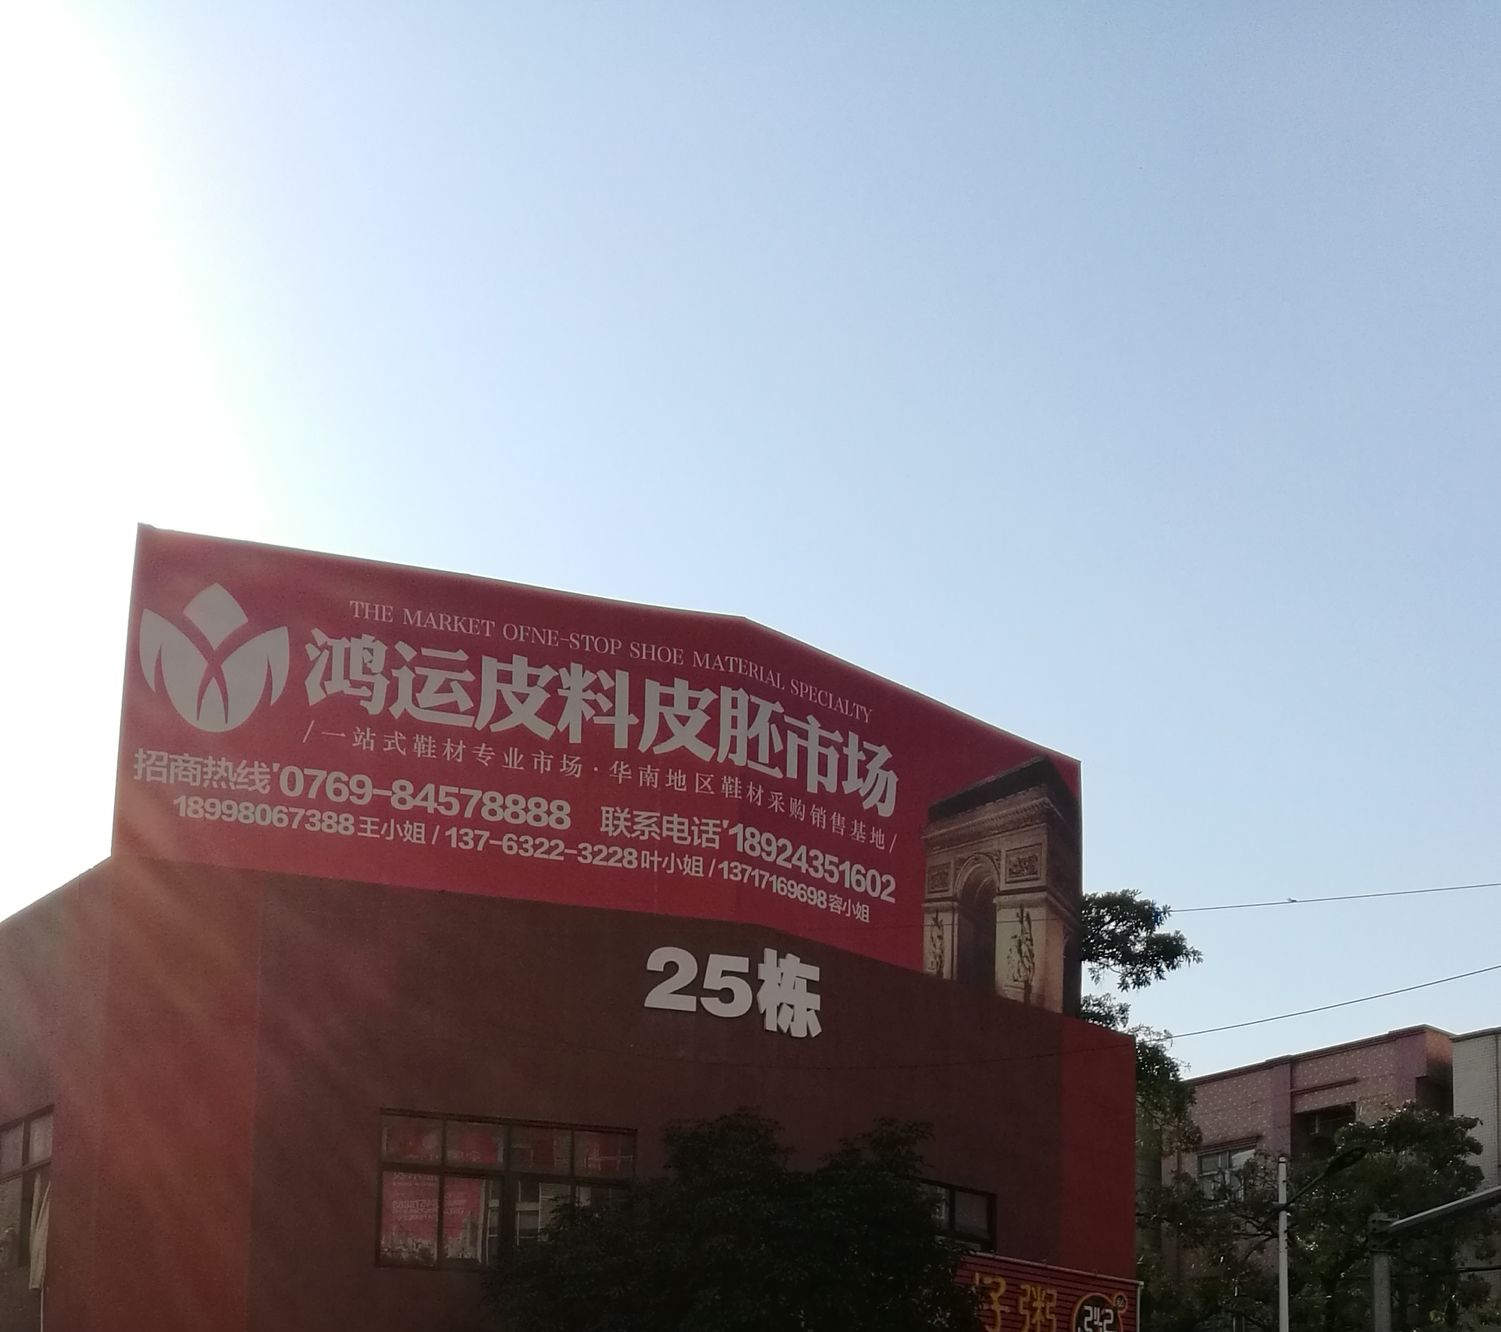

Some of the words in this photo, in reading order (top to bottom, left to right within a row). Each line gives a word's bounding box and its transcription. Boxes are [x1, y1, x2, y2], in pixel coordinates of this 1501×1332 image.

[305, 626, 899, 818] 鸿运皮料皮胚市场
[350, 601, 393, 622] THE
[403, 608, 495, 637] MARKET
[503, 623, 623, 656] OFNE-STOP
[630, 641, 684, 665] SHOE
[693, 651, 785, 690] MATERIAL
[790, 679, 872, 724] SPECIALTY
[644, 946, 823, 1039] 25栋
